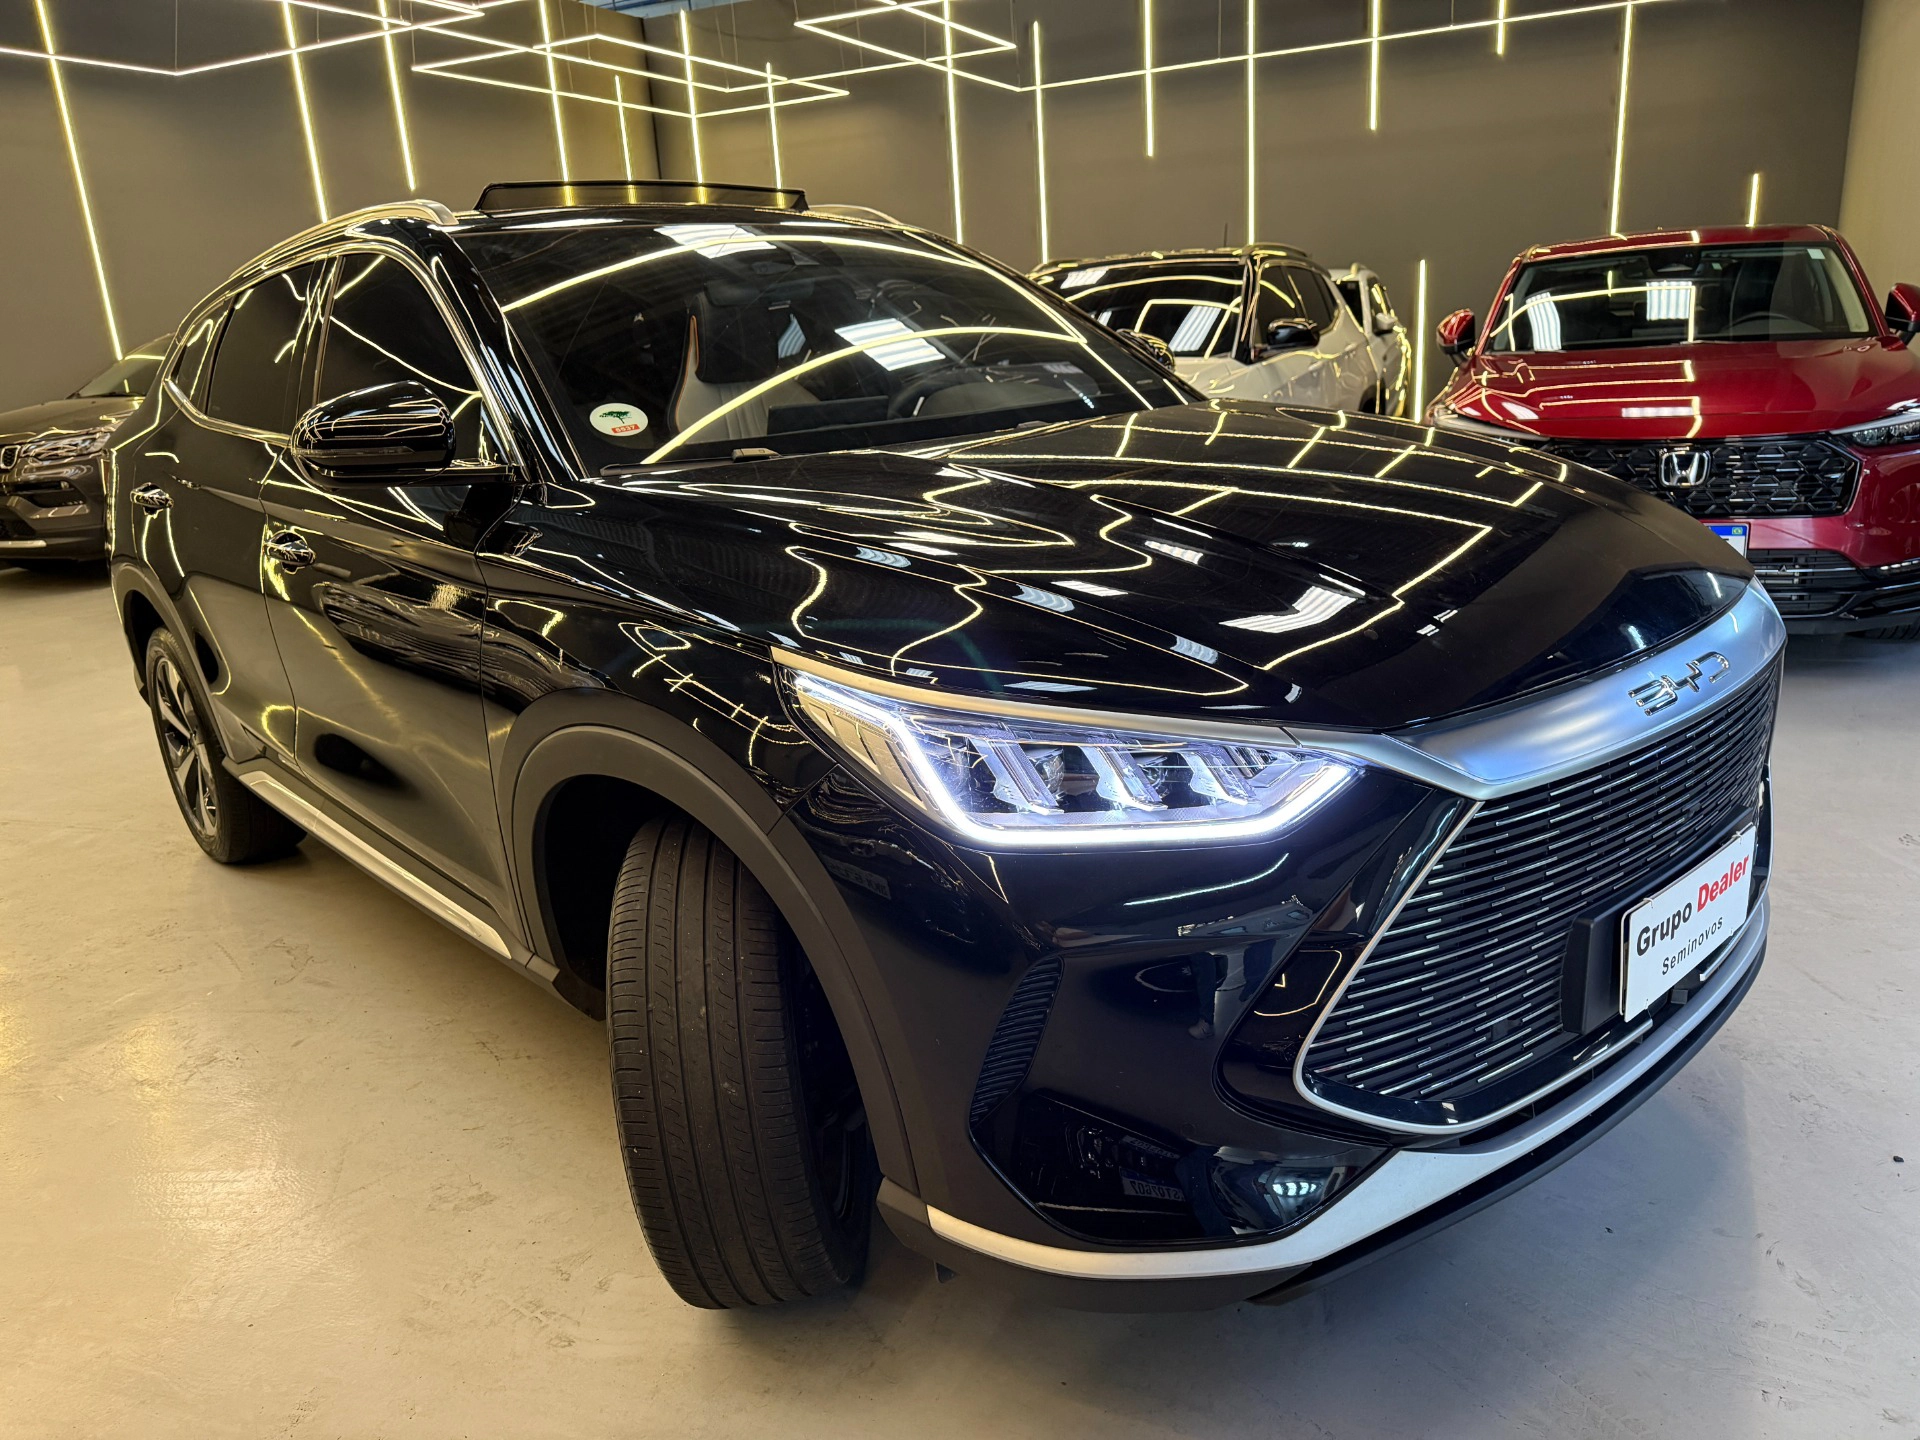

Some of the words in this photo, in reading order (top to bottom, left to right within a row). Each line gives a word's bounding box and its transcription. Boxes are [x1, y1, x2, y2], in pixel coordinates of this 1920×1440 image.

[1627, 651, 1730, 716] BYD
[1636, 902, 1692, 957] Grupo
[1696, 854, 1749, 913] Dealer
[1661, 916, 1723, 976] Seminovos
